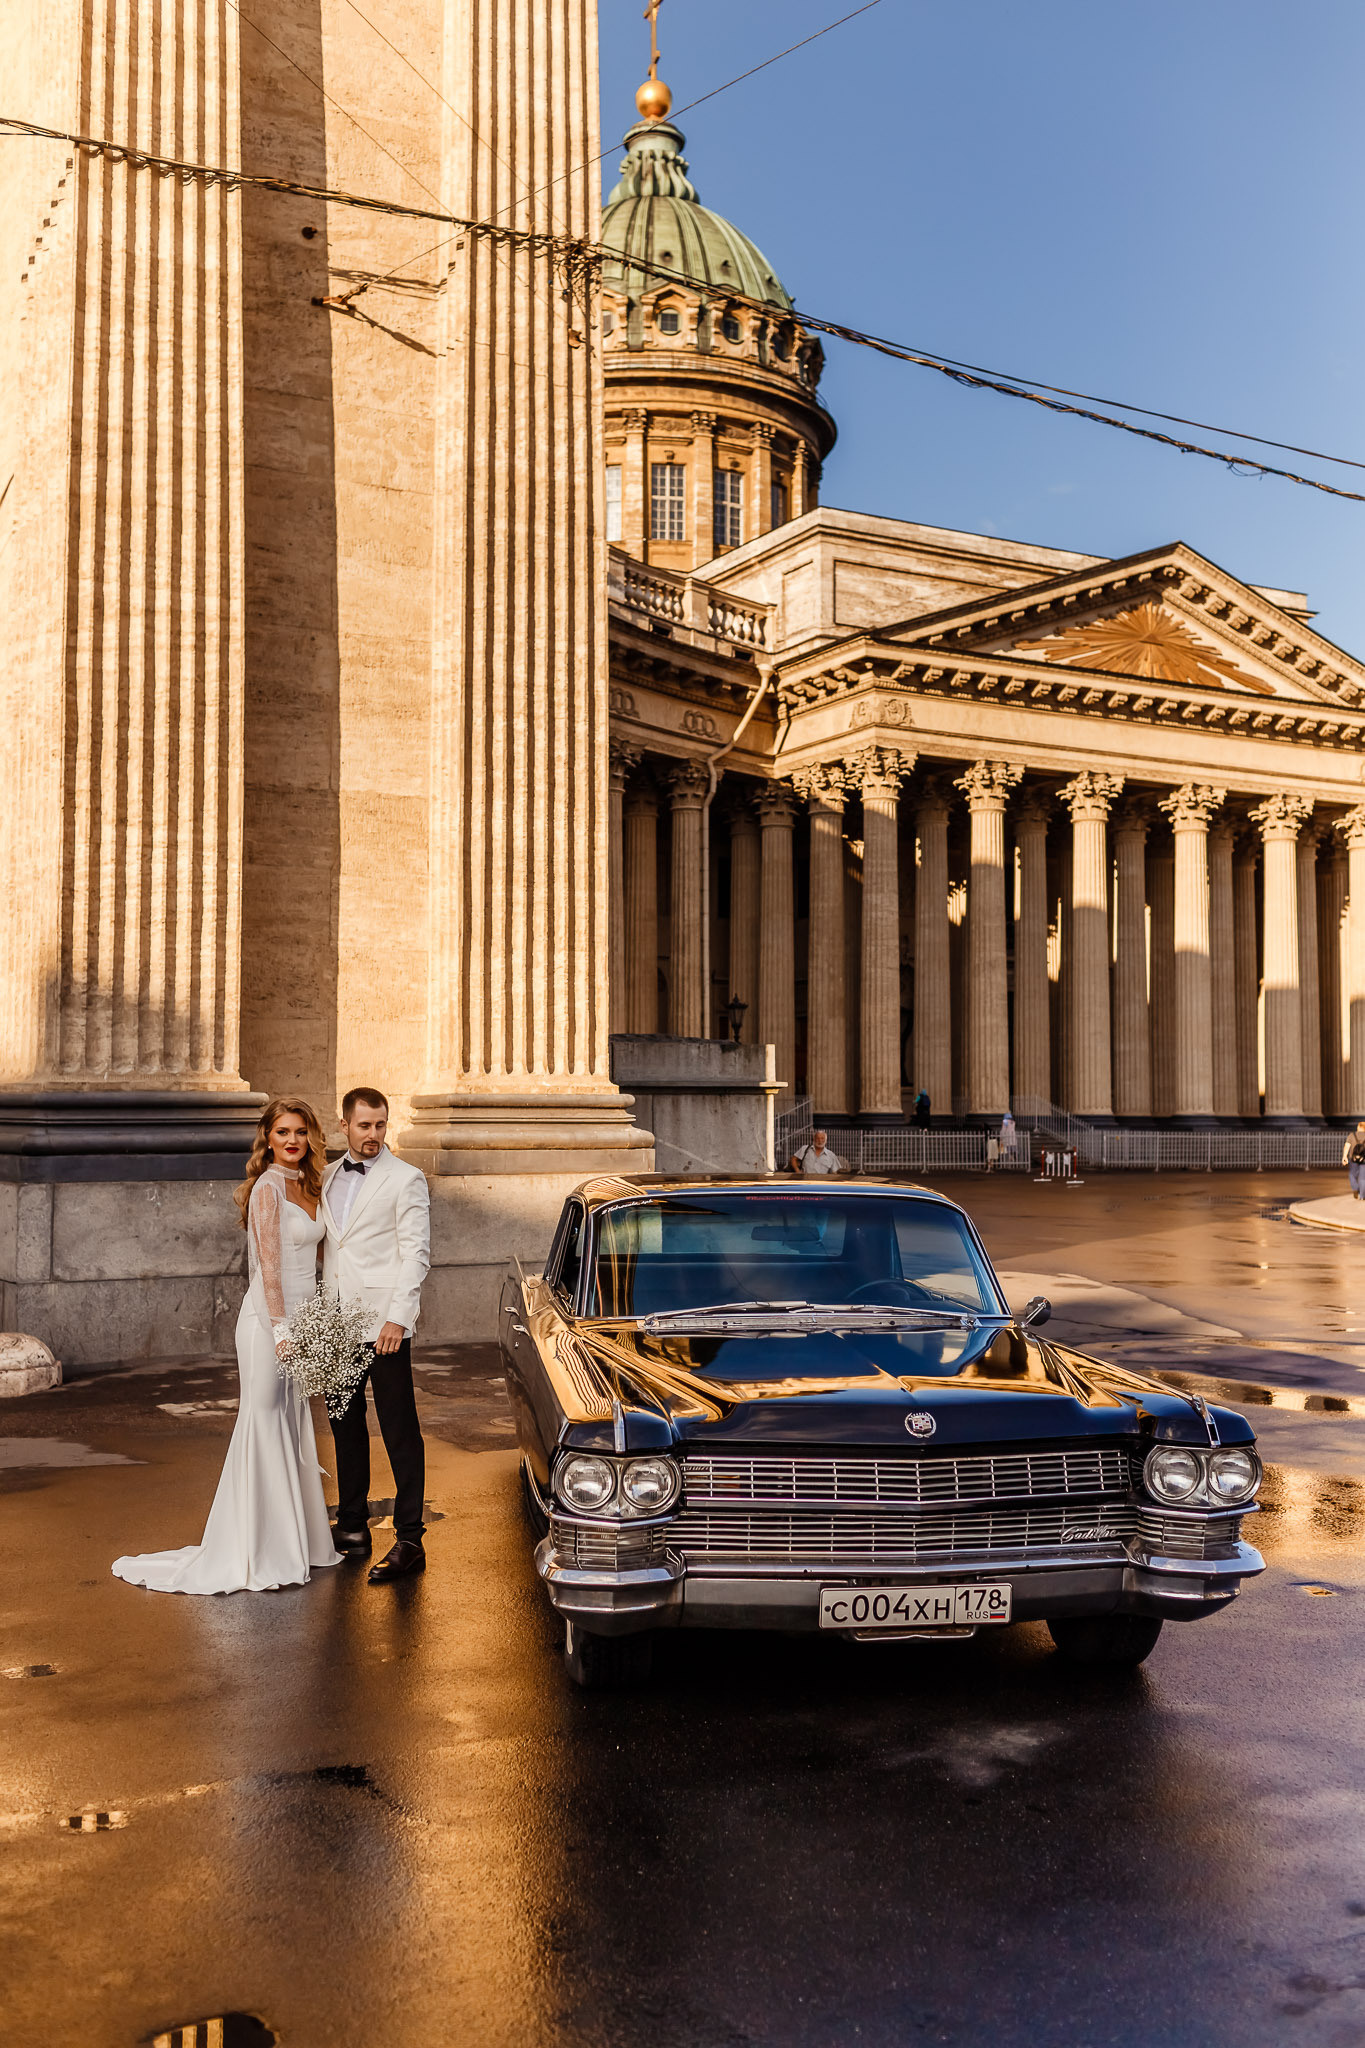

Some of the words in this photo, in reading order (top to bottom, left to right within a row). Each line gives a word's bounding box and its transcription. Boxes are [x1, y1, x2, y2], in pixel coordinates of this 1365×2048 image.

[1061, 1524, 1120, 1543] Cadillac
[958, 1589, 1002, 1611] 178
[967, 1611, 989, 1620] RUS
